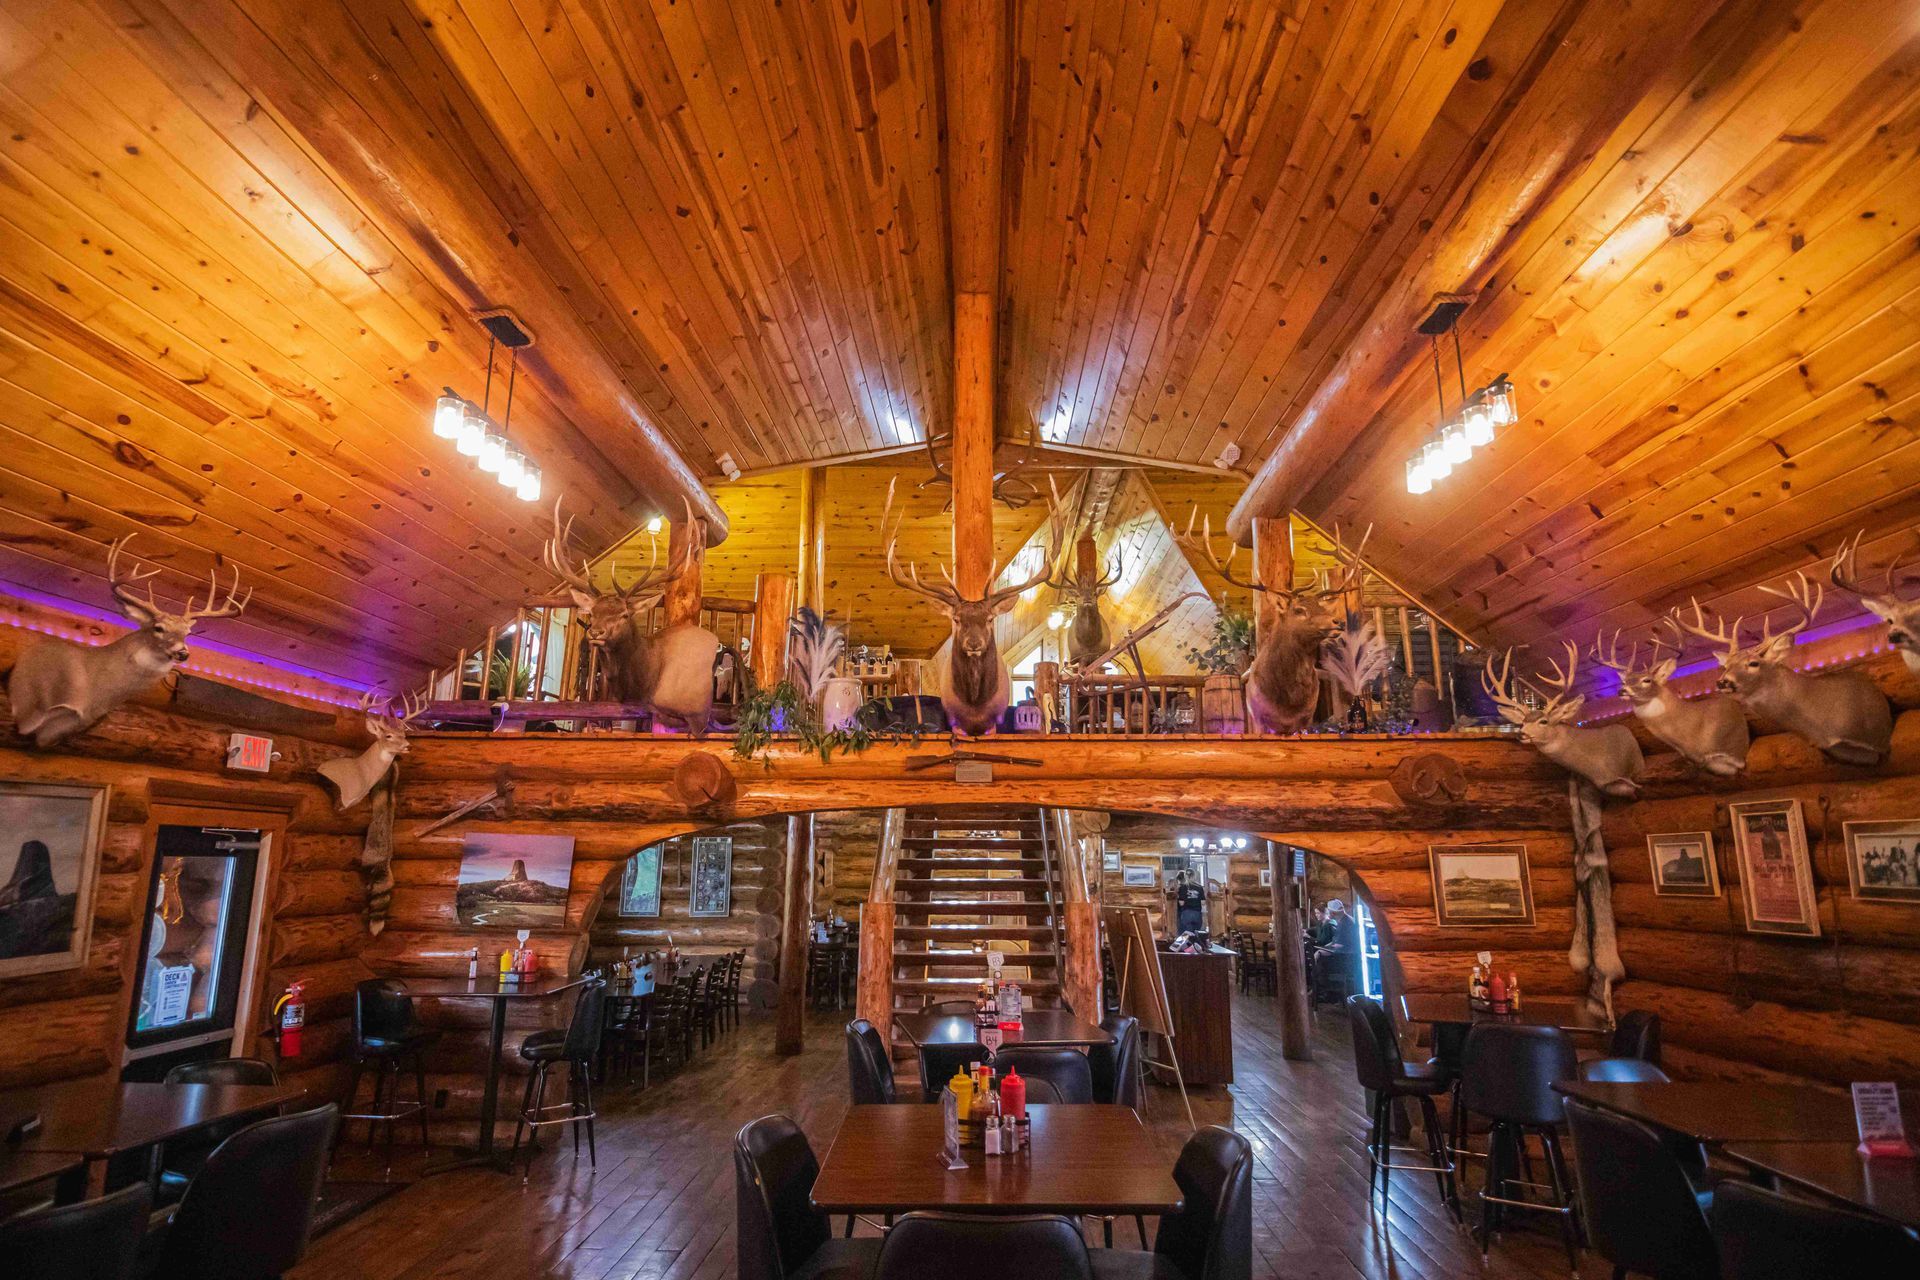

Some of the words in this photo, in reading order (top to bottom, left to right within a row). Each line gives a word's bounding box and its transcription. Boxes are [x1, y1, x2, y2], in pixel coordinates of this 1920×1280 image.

[242, 737, 269, 768] EXIT
[165, 973, 180, 981] DECK
[985, 1035, 997, 1045] B4
